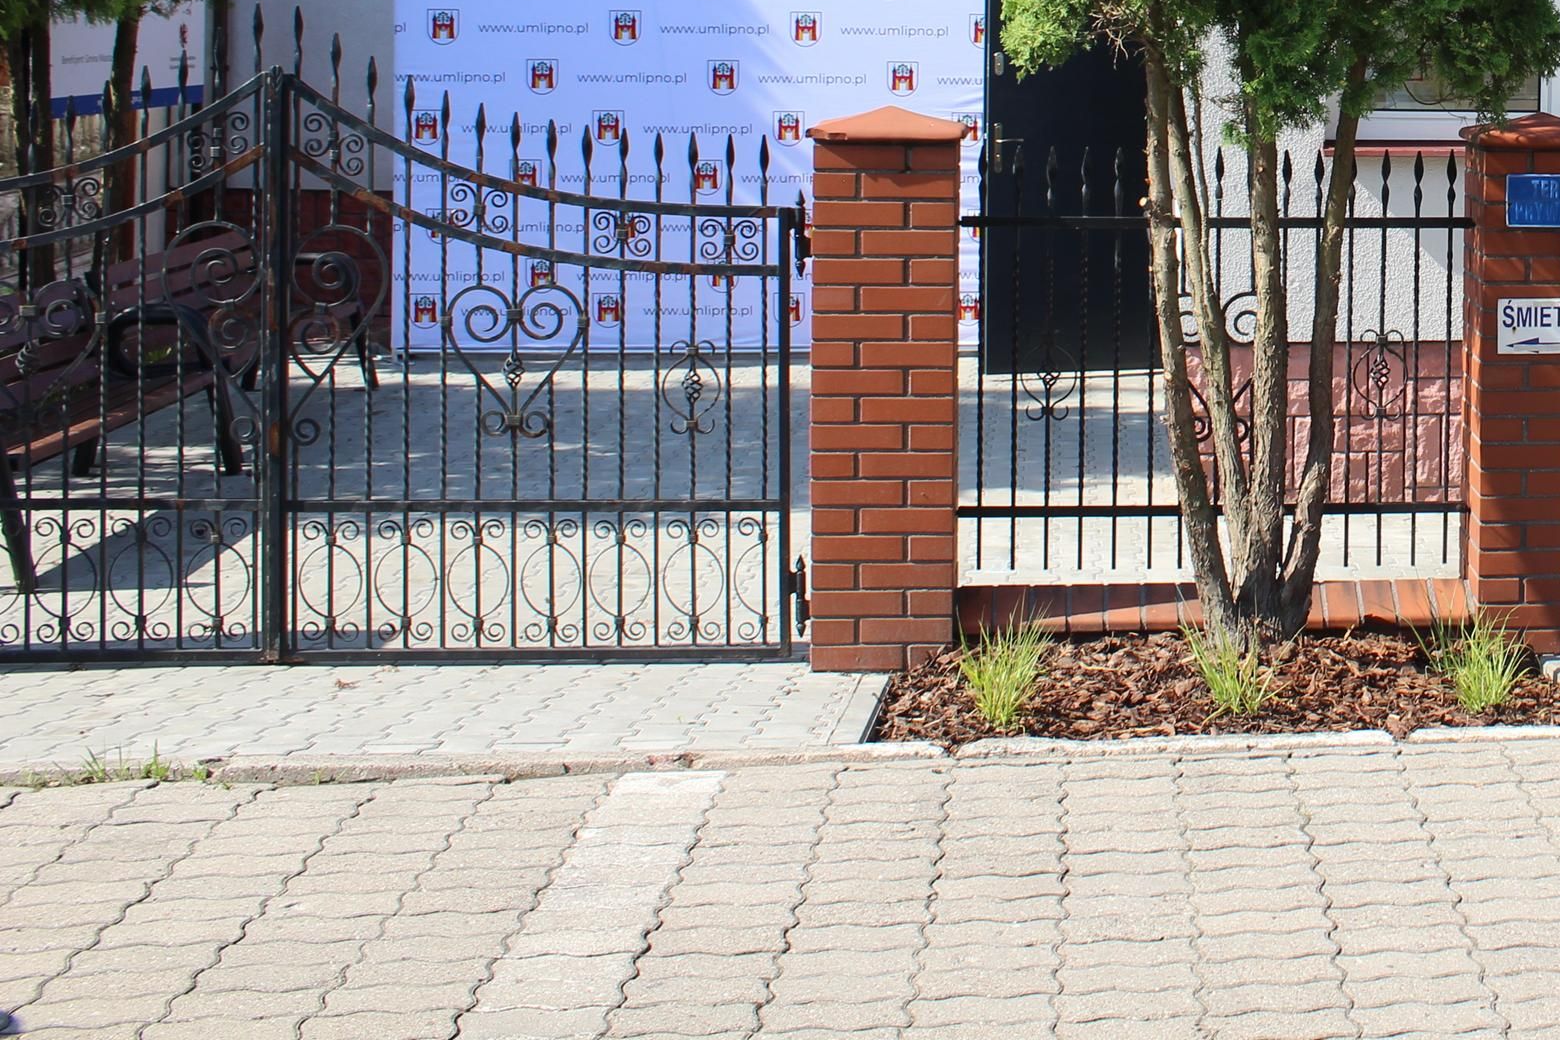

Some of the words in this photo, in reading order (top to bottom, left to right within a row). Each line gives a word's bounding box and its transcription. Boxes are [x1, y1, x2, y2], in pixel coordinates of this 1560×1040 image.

[478, 21, 589, 35] www.umlipno.pl
[661, 22, 770, 36] www.umlipno.pl
[840, 24, 949, 38] www.umlipno.pl
[577, 71, 688, 85] www.umlipno.pl
[758, 72, 868, 86] www.umlipno.pl
